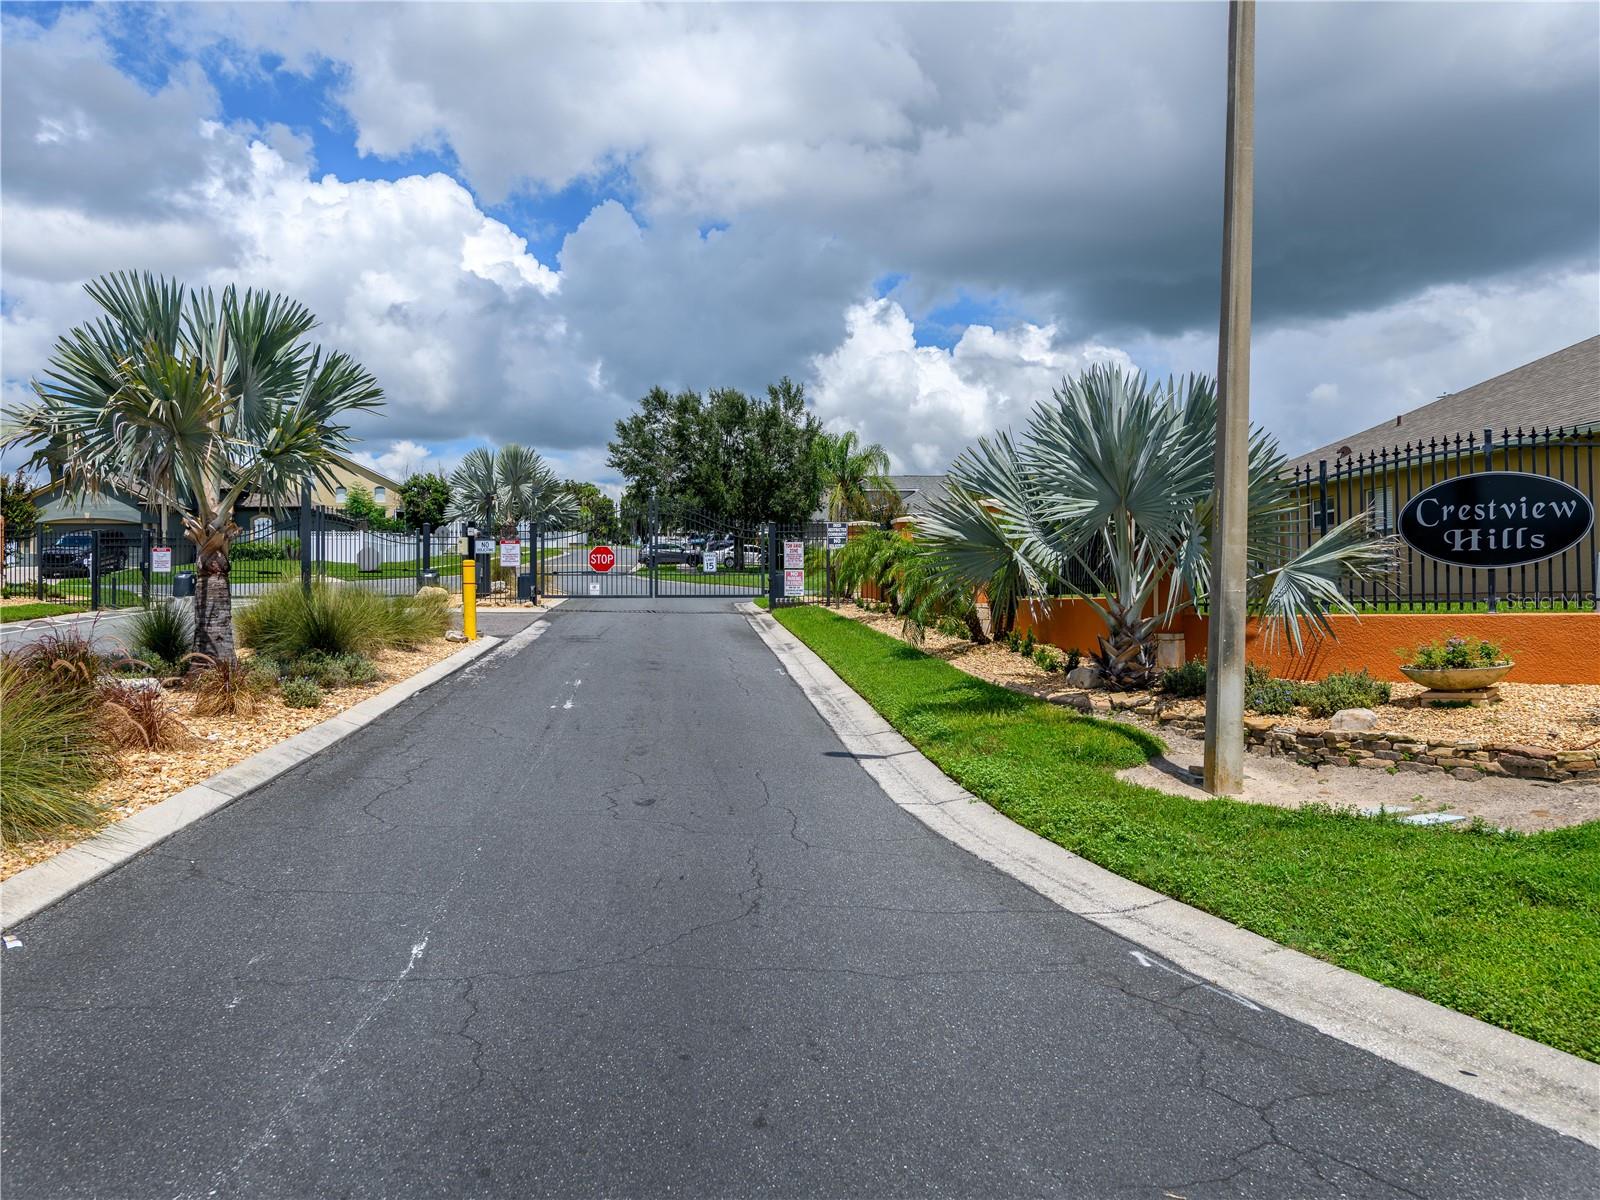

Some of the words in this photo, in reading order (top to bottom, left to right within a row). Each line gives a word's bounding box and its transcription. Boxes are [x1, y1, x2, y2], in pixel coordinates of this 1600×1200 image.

[1415, 496, 1577, 527] Crestview
[1443, 527, 1545, 552] Hills
[590, 554, 614, 564] STOP
[706, 562, 714, 570] 15
